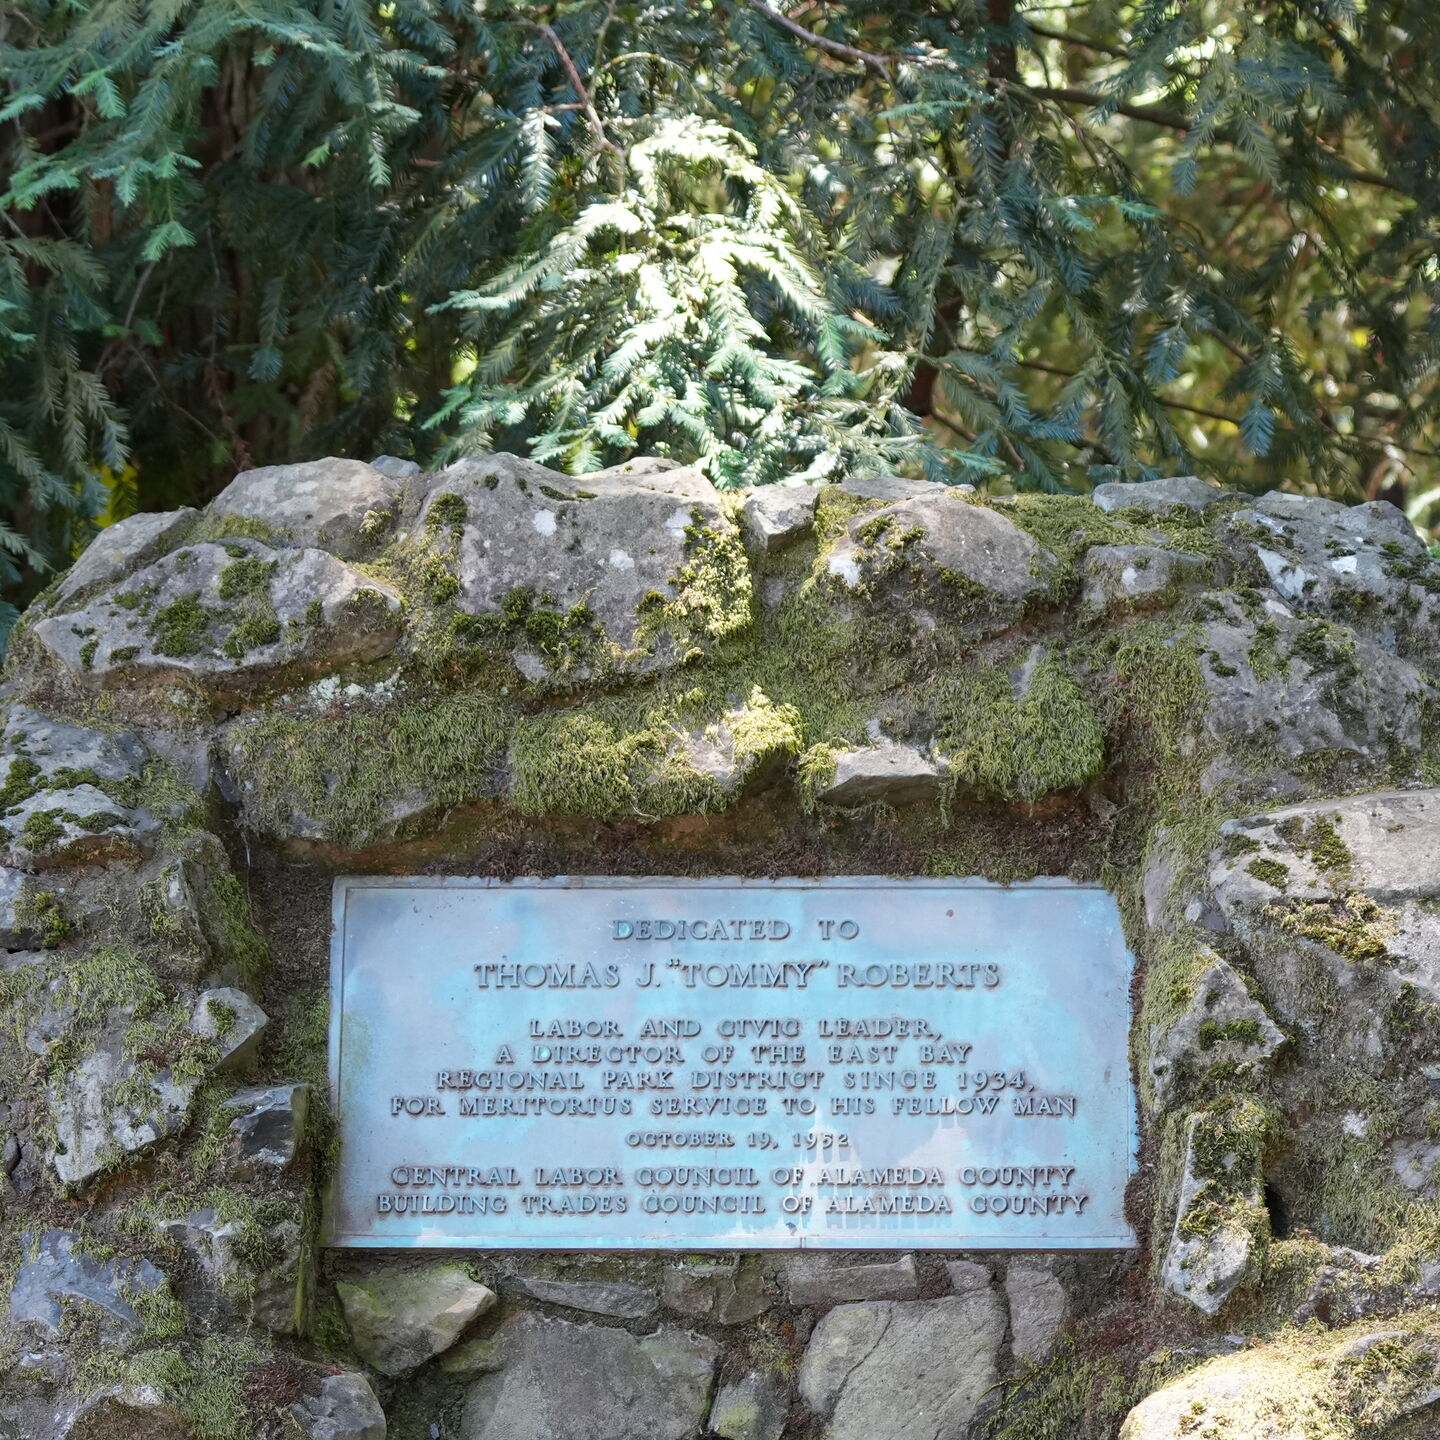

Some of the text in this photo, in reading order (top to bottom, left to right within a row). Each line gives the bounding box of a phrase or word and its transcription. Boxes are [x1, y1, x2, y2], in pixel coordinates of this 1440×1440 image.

[613, 919, 859, 940] DEDICATED TO
[474, 959, 1000, 988] THOMAS J. "TOMMY" ROBERTS
[530, 1019, 943, 1041] LABOR AND CIVIC LEADER,
[496, 1045, 973, 1064] A DIRECTOR OF THE EAST BAY
[437, 1071, 1035, 1092] REGIONAL PARK DISTRICT SINCE 1934,
[391, 1097, 1077, 1116] FOR MERITORIUS SERVICE TO HIS FELLOW MAN
[625, 1132, 849, 1150] OCTOBER 19, 1952
[391, 1166, 1076, 1187] CENTRAL LABOR COUNCIL OF ALAMEDA COUNTY
[377, 1195, 1088, 1215] BUILDING TRADES COUNCIL OF ALAMEDA COUNTY
